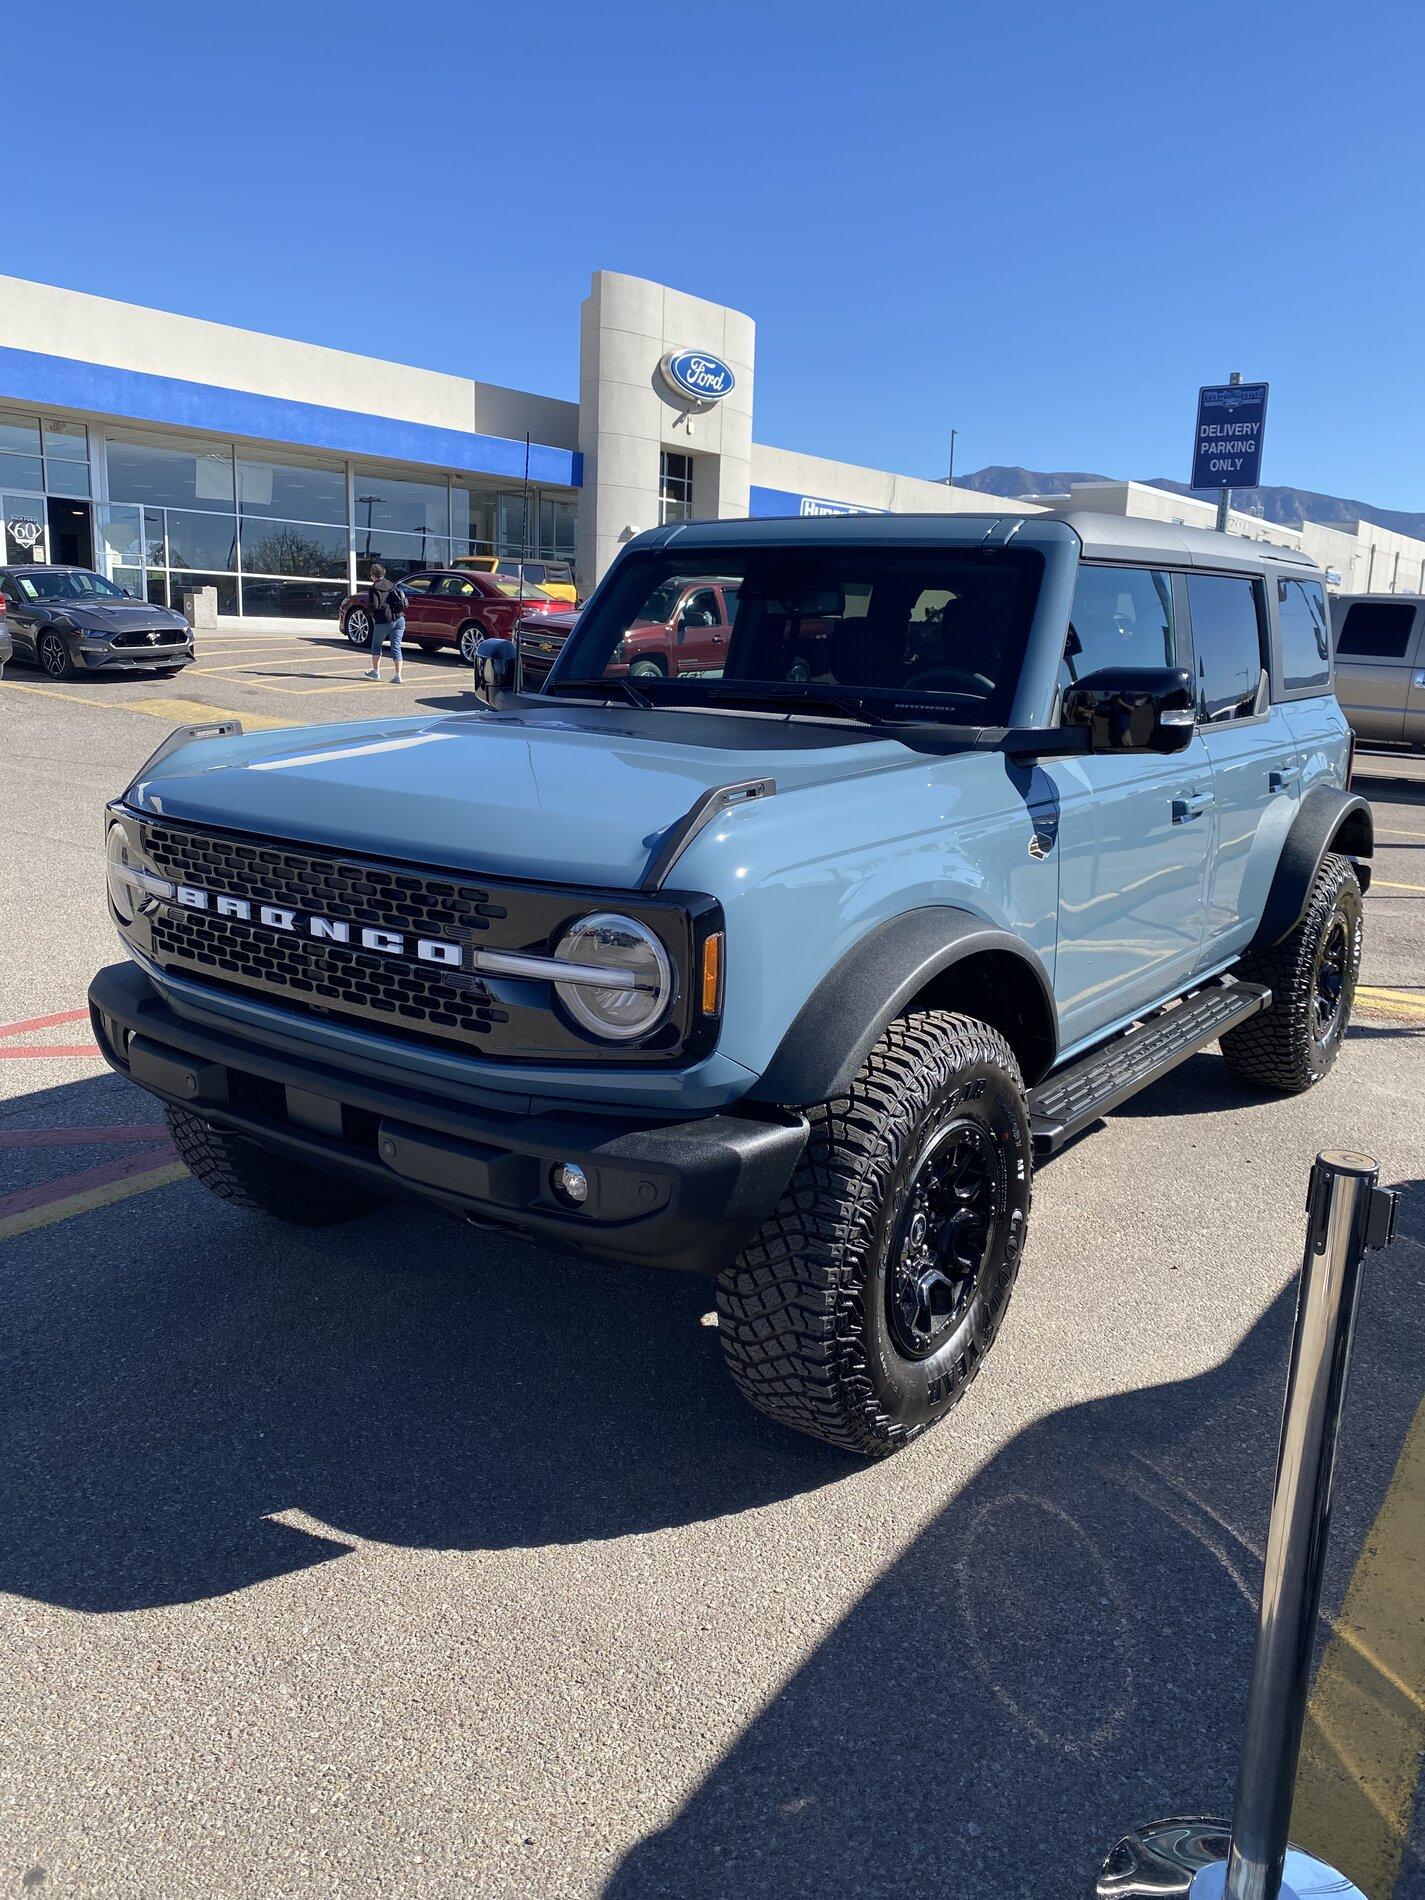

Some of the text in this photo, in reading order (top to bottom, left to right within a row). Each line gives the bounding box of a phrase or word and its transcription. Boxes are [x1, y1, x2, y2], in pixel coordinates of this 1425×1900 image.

[686, 357, 725, 391] Ford
[1200, 422, 1260, 437] DELIVERY
[1200, 440, 1256, 455] PARKING
[1209, 458, 1244, 472] ONLY
[14, 522, 36, 540] 60
[176, 884, 463, 967] BRONCO
